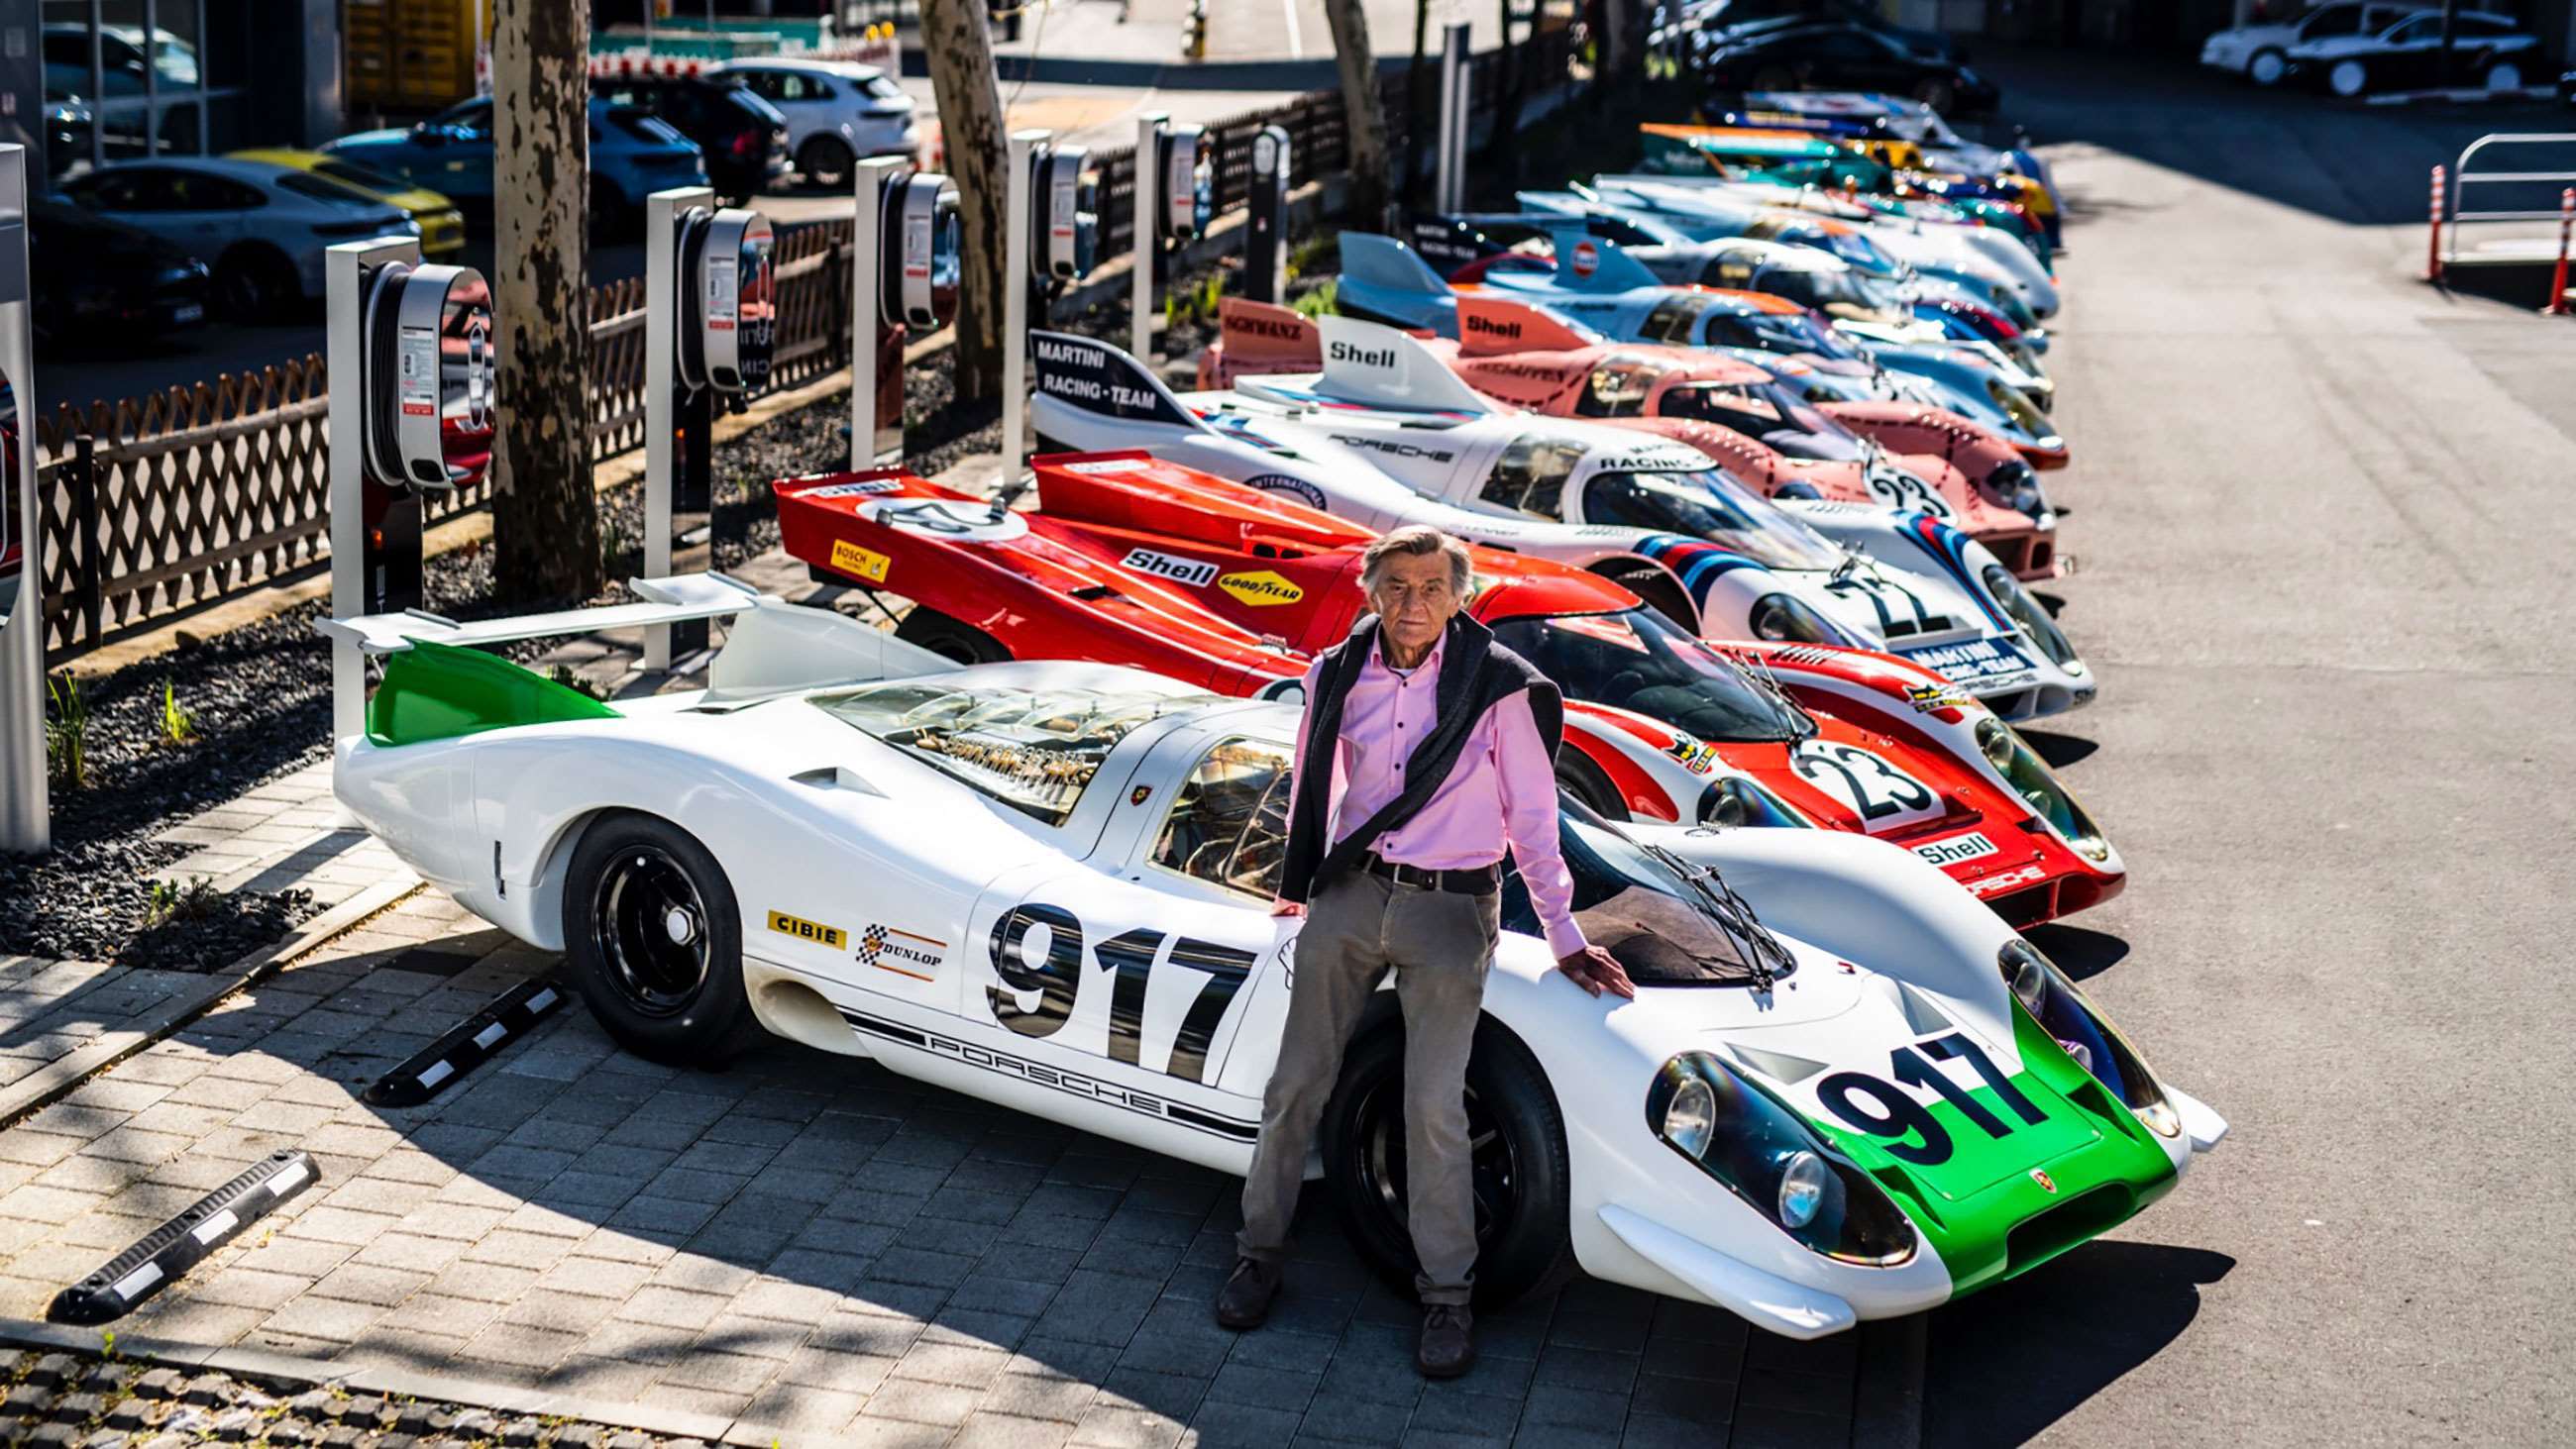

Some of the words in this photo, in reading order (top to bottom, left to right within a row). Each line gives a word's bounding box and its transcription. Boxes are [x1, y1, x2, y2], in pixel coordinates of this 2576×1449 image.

[1466, 315, 1522, 339] Shell
[1038, 341, 1106, 368] MARTINI
[1330, 342, 1396, 368] Shell
[1329, 434, 1454, 464] PORSCHE
[1873, 475, 1950, 516] 23
[836, 545, 867, 565] BOSCH
[1126, 551, 1215, 584] Shell
[1221, 575, 1300, 600] GOODYEAR
[1911, 640, 1999, 668] MARTINI
[1794, 747, 1932, 821] 23
[1918, 834, 1994, 865] Shell
[777, 916, 837, 945] CIBIE
[883, 943, 942, 967] DUNLOP
[985, 902, 1258, 1085] 917
[930, 1037, 1162, 1115] PORSCHE
[1816, 1031, 2050, 1166] 917
